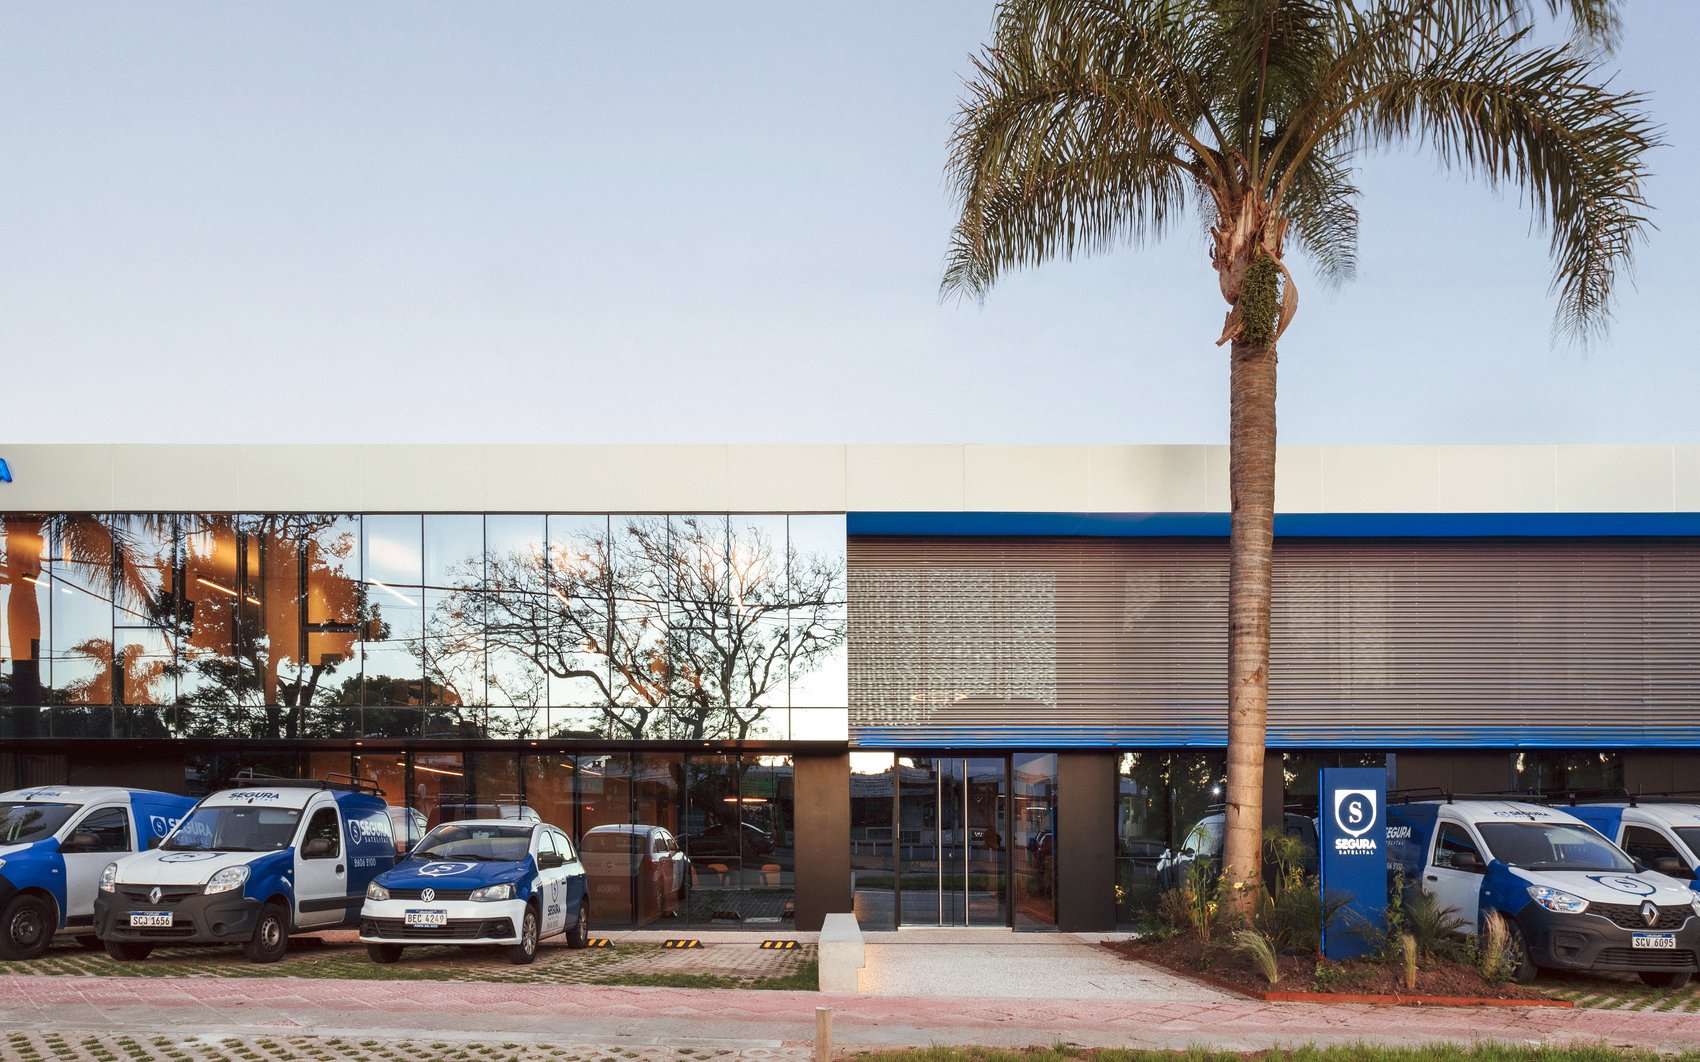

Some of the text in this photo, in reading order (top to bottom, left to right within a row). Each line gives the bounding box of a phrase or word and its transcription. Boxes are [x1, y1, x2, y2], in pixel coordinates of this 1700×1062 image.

[229, 791, 280, 799] SEGURA
[1348, 801, 1363, 823] S
[168, 817, 213, 838] SGURA
[1335, 838, 1377, 850] SEGURA
[133, 916, 170, 926] SCJ 1656
[407, 914, 444, 923] BEC 4249
[1635, 938, 1674, 947] SCV 6095
